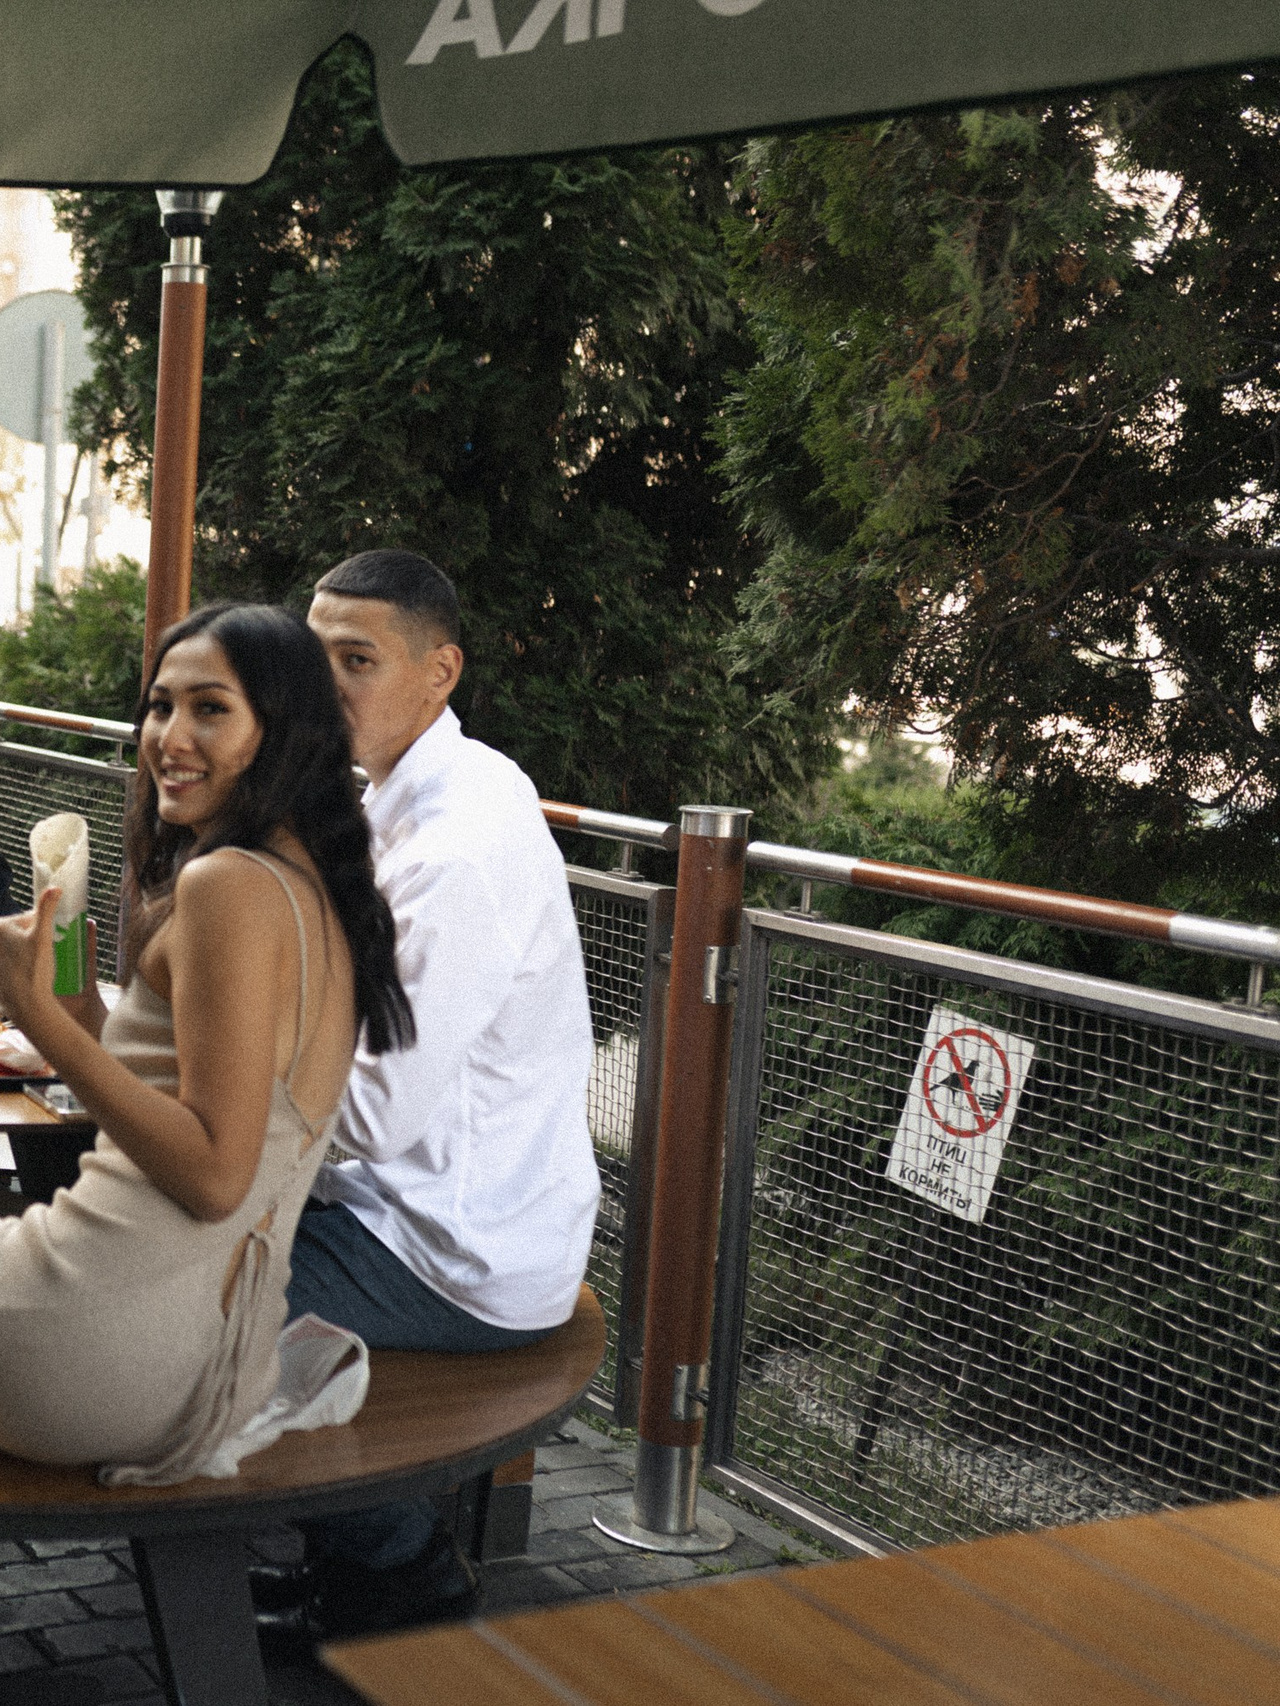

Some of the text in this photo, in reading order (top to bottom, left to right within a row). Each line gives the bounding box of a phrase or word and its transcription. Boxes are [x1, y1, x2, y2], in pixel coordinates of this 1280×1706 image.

[926, 1135, 967, 1167] ПТИЦ
[931, 1158, 952, 1176] НЕ
[899, 1165, 972, 1212] КОРМИТЬ!
